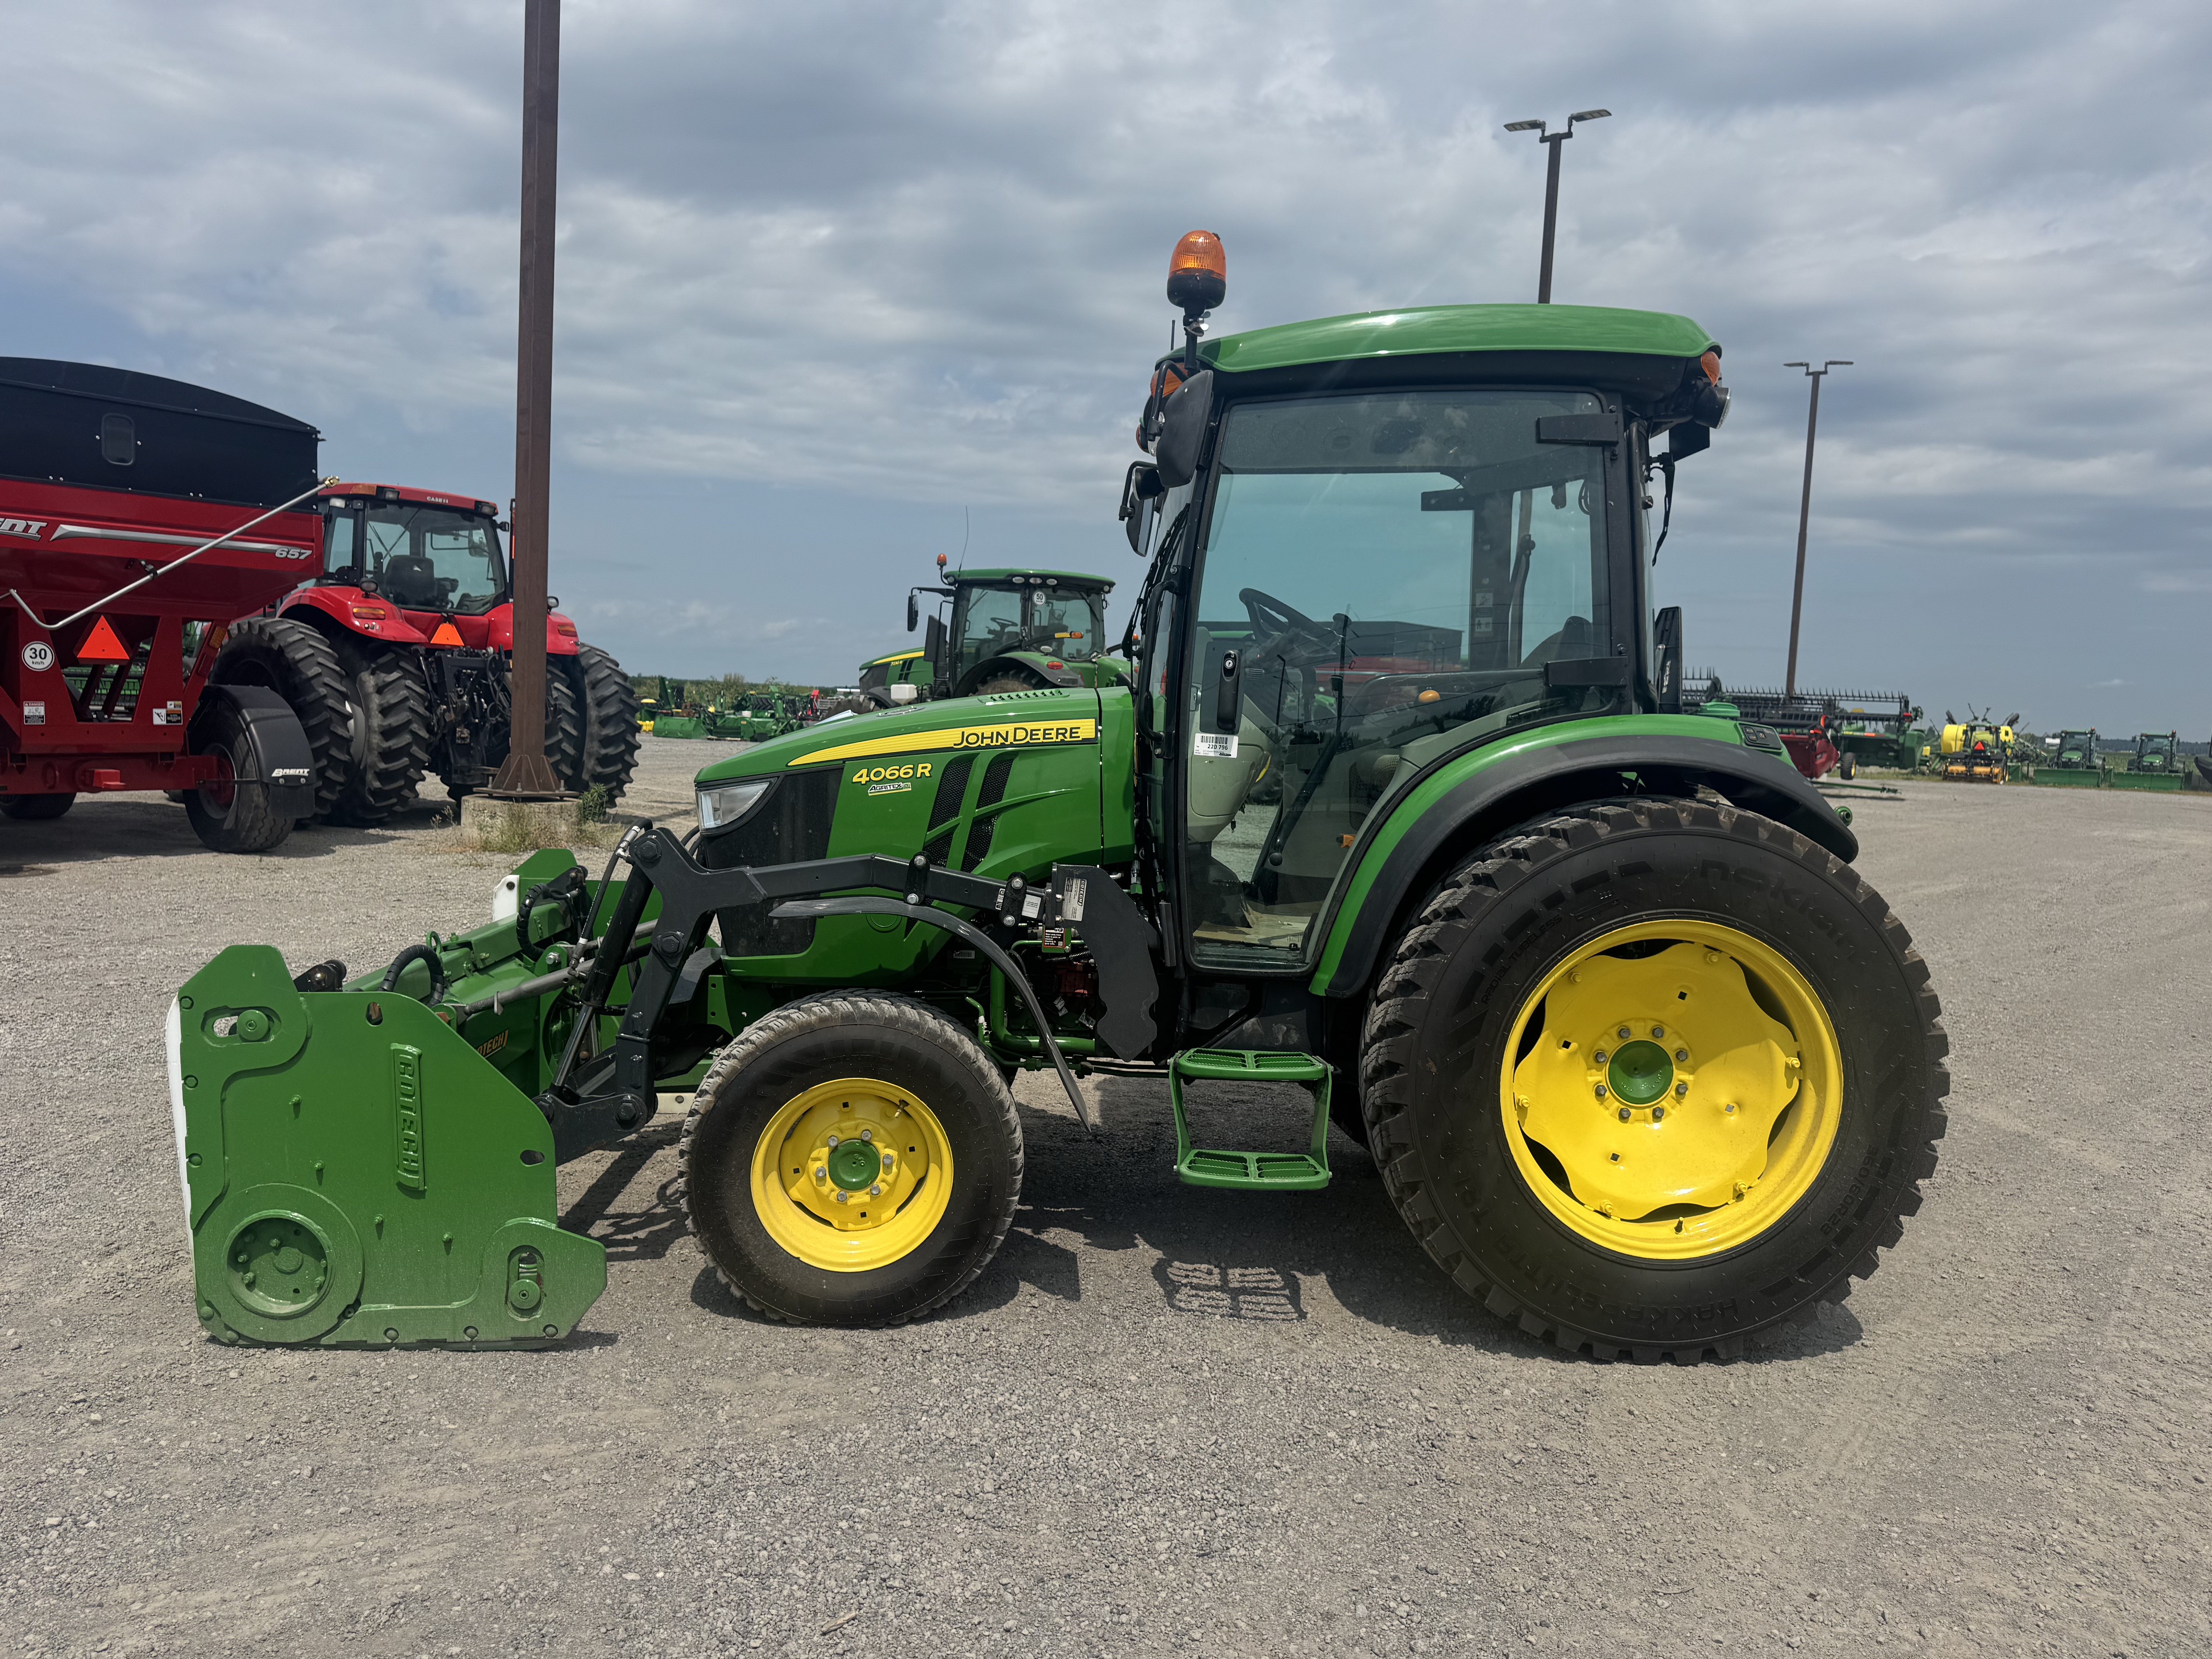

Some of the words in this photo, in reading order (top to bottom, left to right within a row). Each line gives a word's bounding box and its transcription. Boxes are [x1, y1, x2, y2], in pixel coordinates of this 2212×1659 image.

[275, 548, 312, 560] 657
[29, 647, 47, 659] 30
[953, 730, 1009, 746] JOHN
[1013, 727, 1081, 742] DEERE
[271, 768, 309, 777] BRENT
[852, 764, 914, 784] 4066
[916, 763, 932, 778] R
[869, 783, 902, 792] AGRITEX
[1508, 912, 1563, 963] TUBELESS
